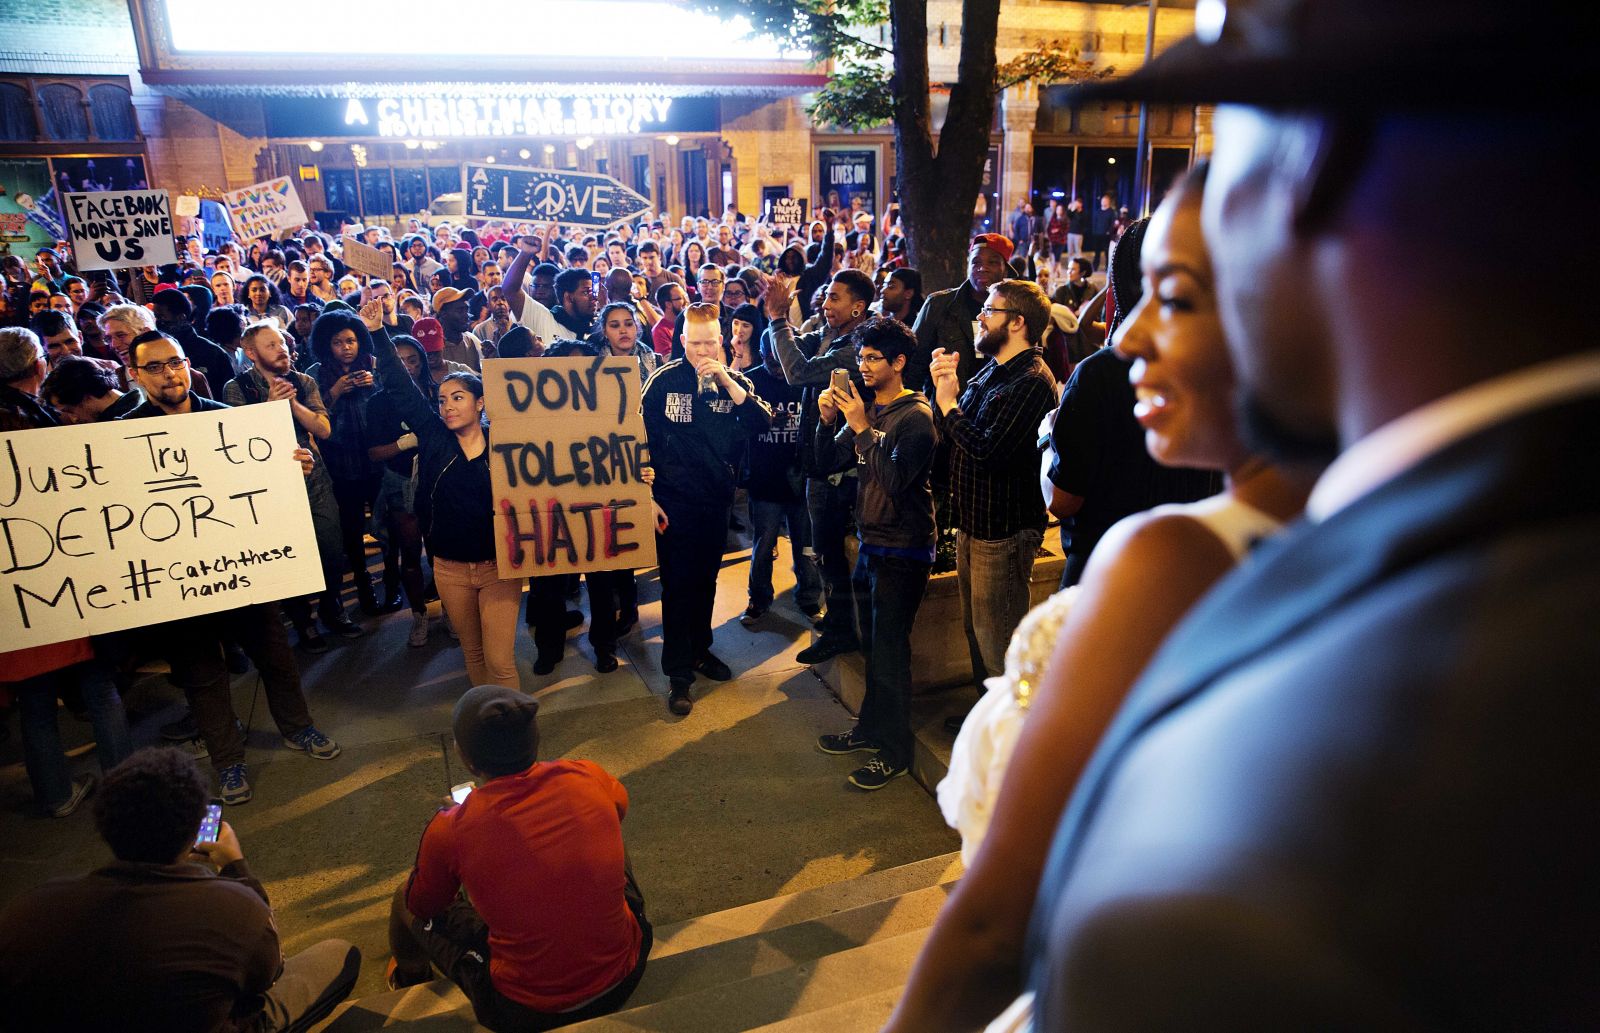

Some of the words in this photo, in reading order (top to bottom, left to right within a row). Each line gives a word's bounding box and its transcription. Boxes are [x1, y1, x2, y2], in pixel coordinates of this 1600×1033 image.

[344, 98, 369, 125] A
[378, 98, 562, 123] CHRISTMAS
[573, 97, 672, 122] STORY
[830, 165, 853, 185] LIVES
[854, 165, 867, 184] ON
[225, 186, 274, 209] LOVE
[472, 168, 488, 216] ATL
[69, 194, 166, 222] FACEBOOK
[71, 219, 128, 241] WON'T
[133, 217, 171, 237] SAVE
[95, 238, 145, 262] US
[504, 356, 632, 424] DON'T
[666, 397, 693, 406] BLACK
[665, 405, 693, 415] LIVES
[776, 401, 802, 413] ACK
[758, 431, 798, 444] MATTE
[0, 438, 110, 508] Just
[123, 431, 189, 477] Try
[214, 421, 273, 465] to
[491, 433, 650, 487] TOLERATE
[0, 488, 268, 575] DEPORT
[501, 498, 639, 568] HATE
[180, 573, 251, 601] hands
[13, 576, 127, 629] Me.
